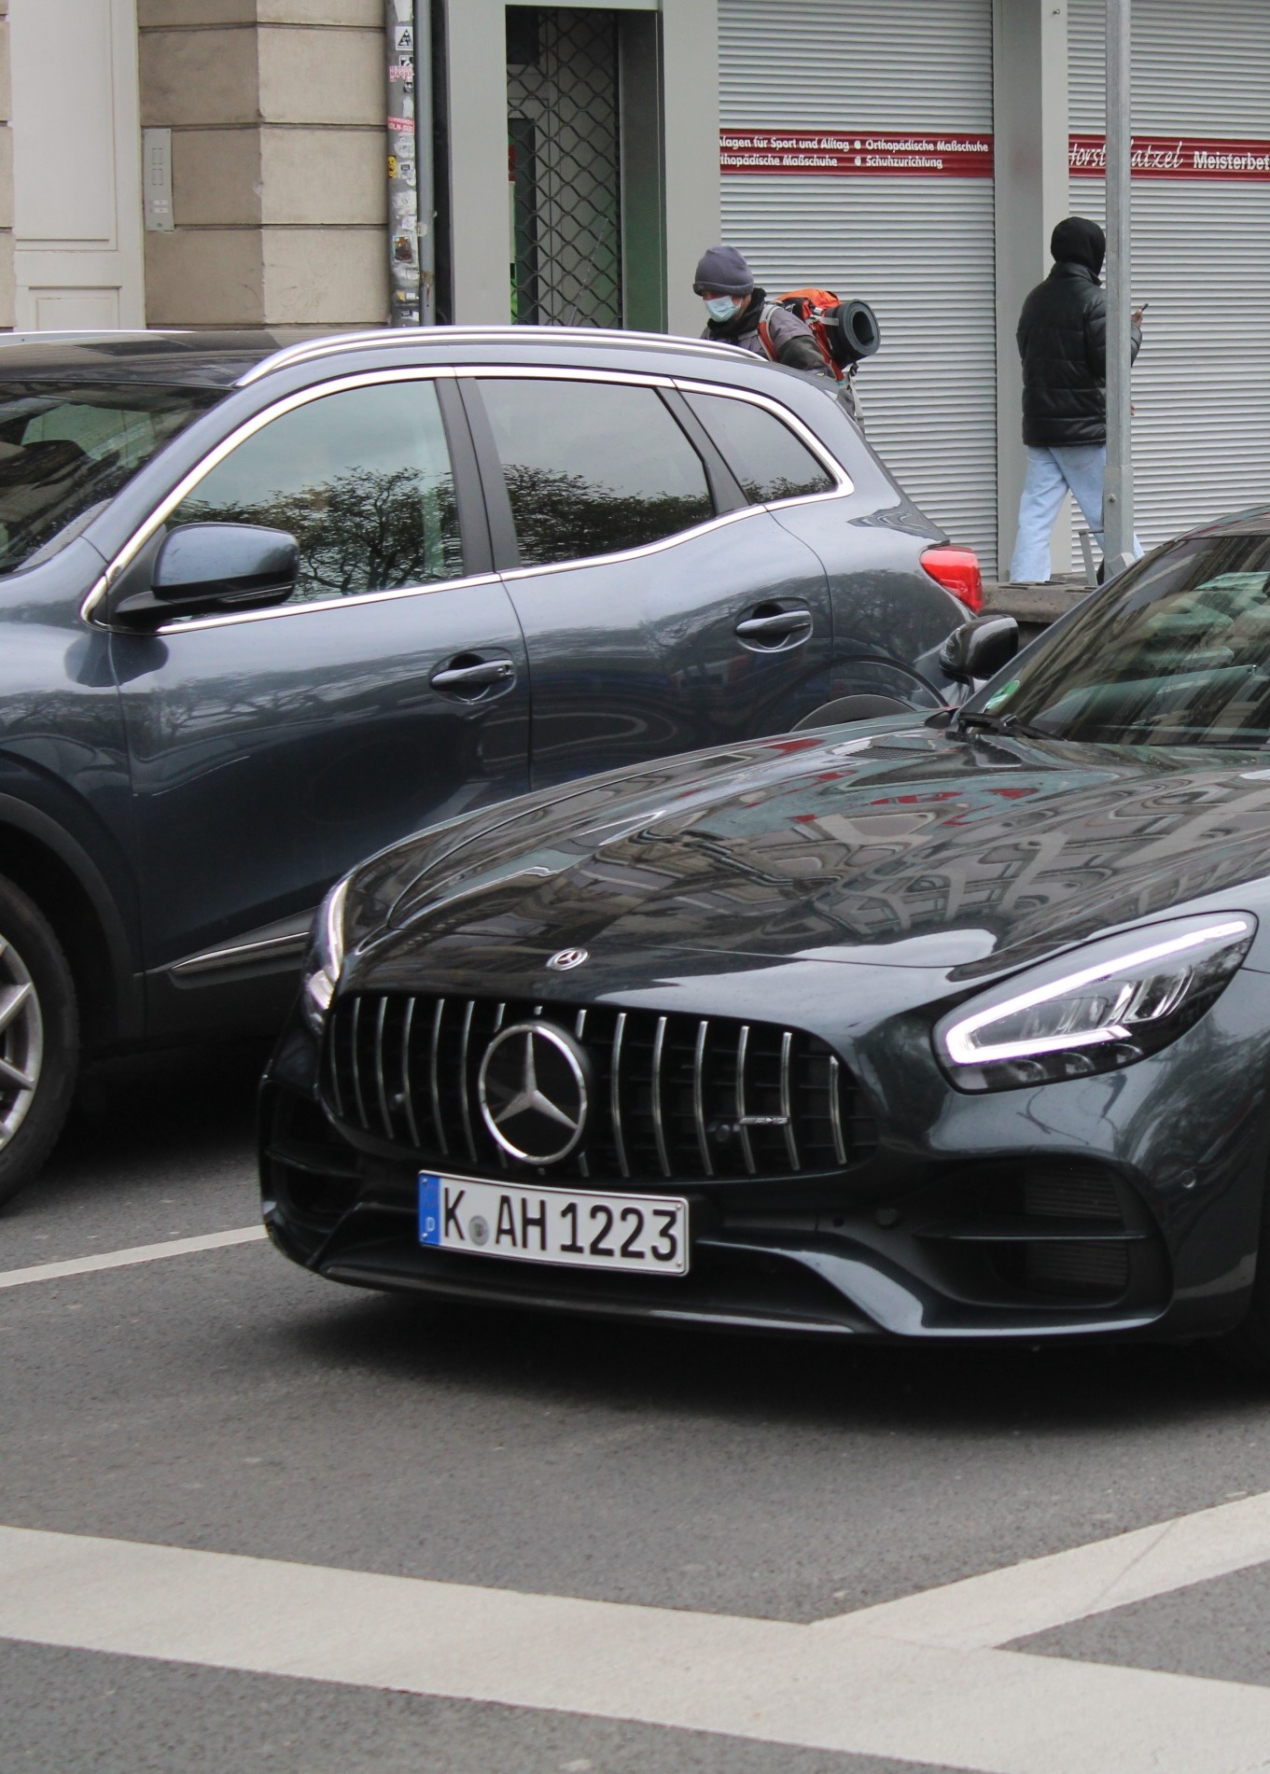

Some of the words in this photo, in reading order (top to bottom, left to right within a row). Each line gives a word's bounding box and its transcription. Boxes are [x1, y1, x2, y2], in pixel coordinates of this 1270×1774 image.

[754, 136, 768, 147] für
[771, 137, 796, 150] Sport
[800, 138, 818, 148] und
[866, 140, 934, 153] Orthopädische
[937, 141, 988, 152] Maßschuhe
[783, 154, 837, 166] Maßschuhe
[1131, 139, 1183, 168] atzel
[866, 155, 943, 169] Schuhzurichtung
[425, 1216, 435, 1232] D
[445, 1187, 466, 1241] K
[495, 1194, 546, 1251] AH
[560, 1202, 678, 1262] 1223
